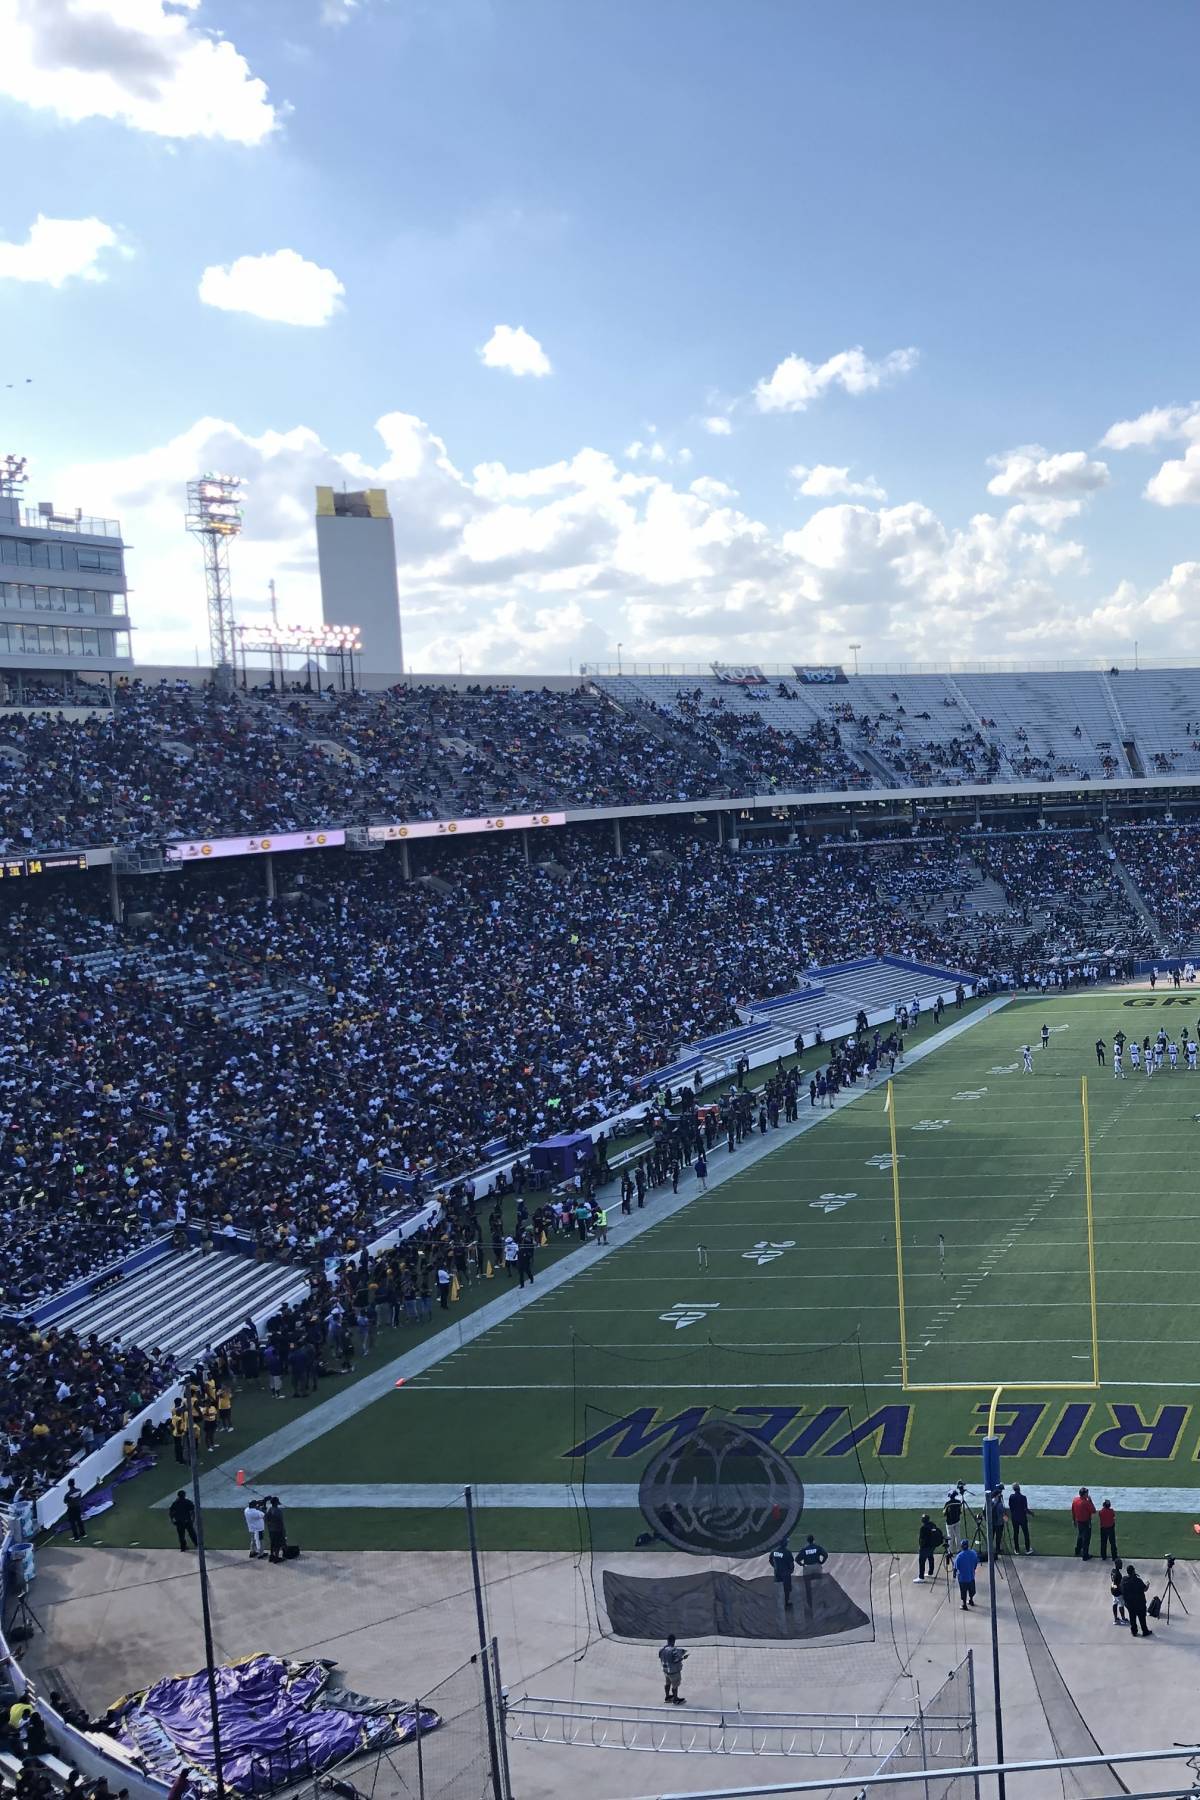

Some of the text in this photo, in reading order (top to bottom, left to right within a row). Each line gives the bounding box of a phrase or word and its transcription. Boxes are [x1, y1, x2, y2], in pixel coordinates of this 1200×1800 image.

[741, 1240, 796, 1260] 20
[658, 1302, 721, 1321] 10
[556, 1404, 917, 1459] VIEW
